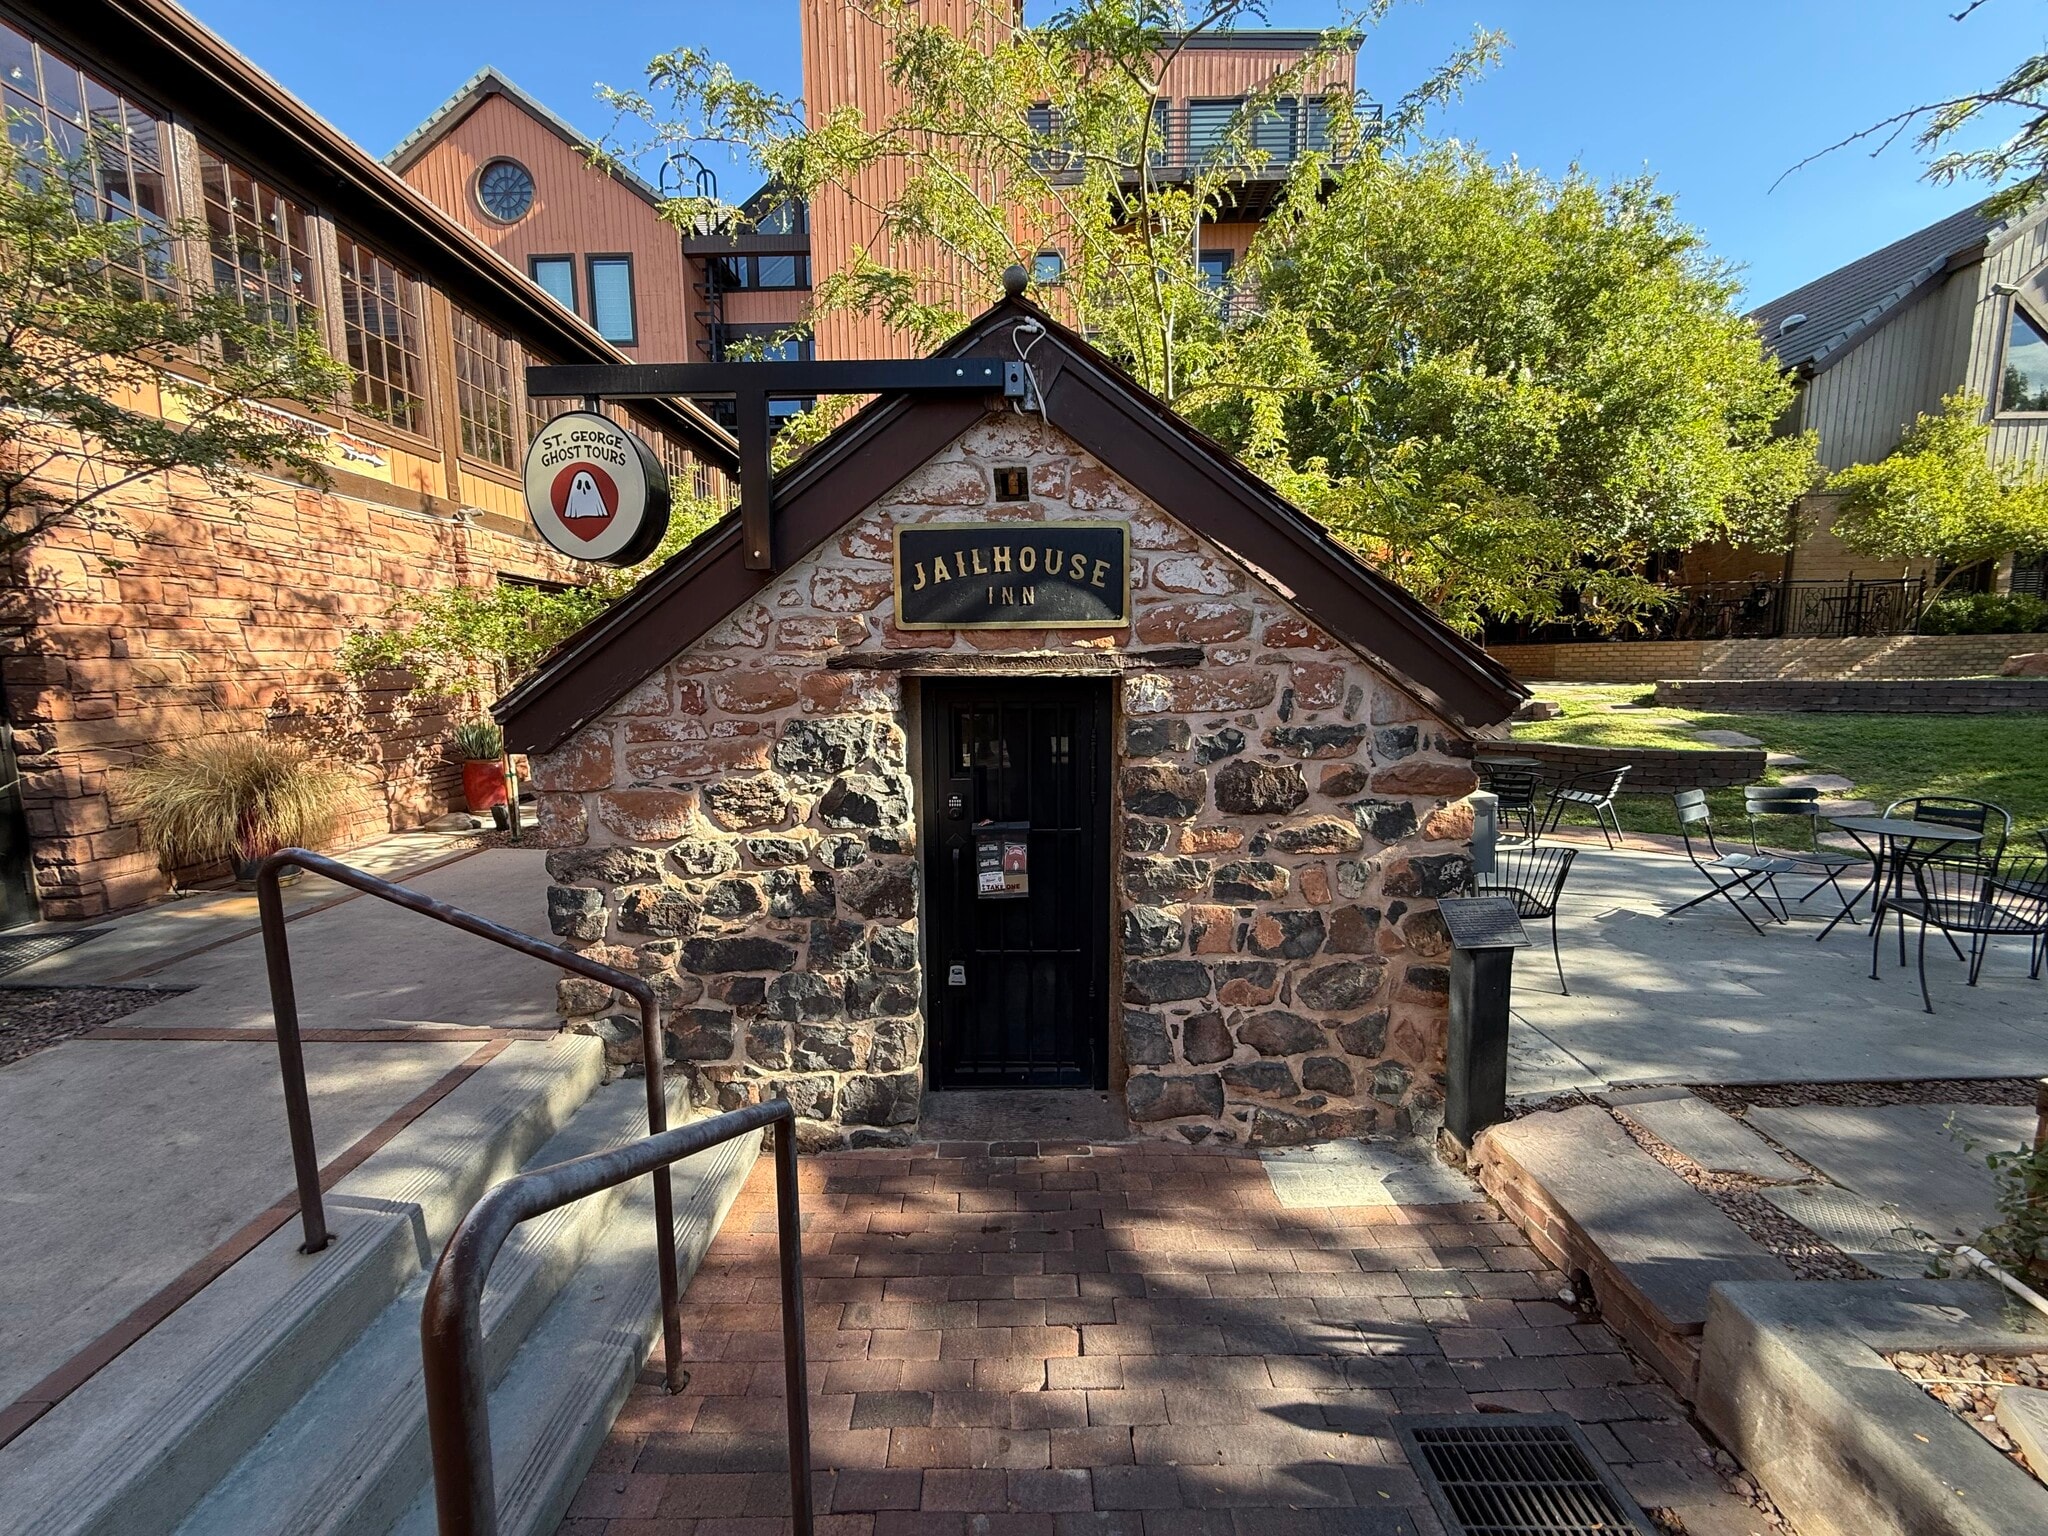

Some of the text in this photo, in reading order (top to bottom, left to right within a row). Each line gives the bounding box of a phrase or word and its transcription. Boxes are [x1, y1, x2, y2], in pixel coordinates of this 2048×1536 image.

[542, 431, 624, 451] ST. GEORGE
[541, 444, 626, 467] GHOST TOURS
[913, 546, 1112, 591] JAILHOUSE
[988, 586, 1036, 606] INN
